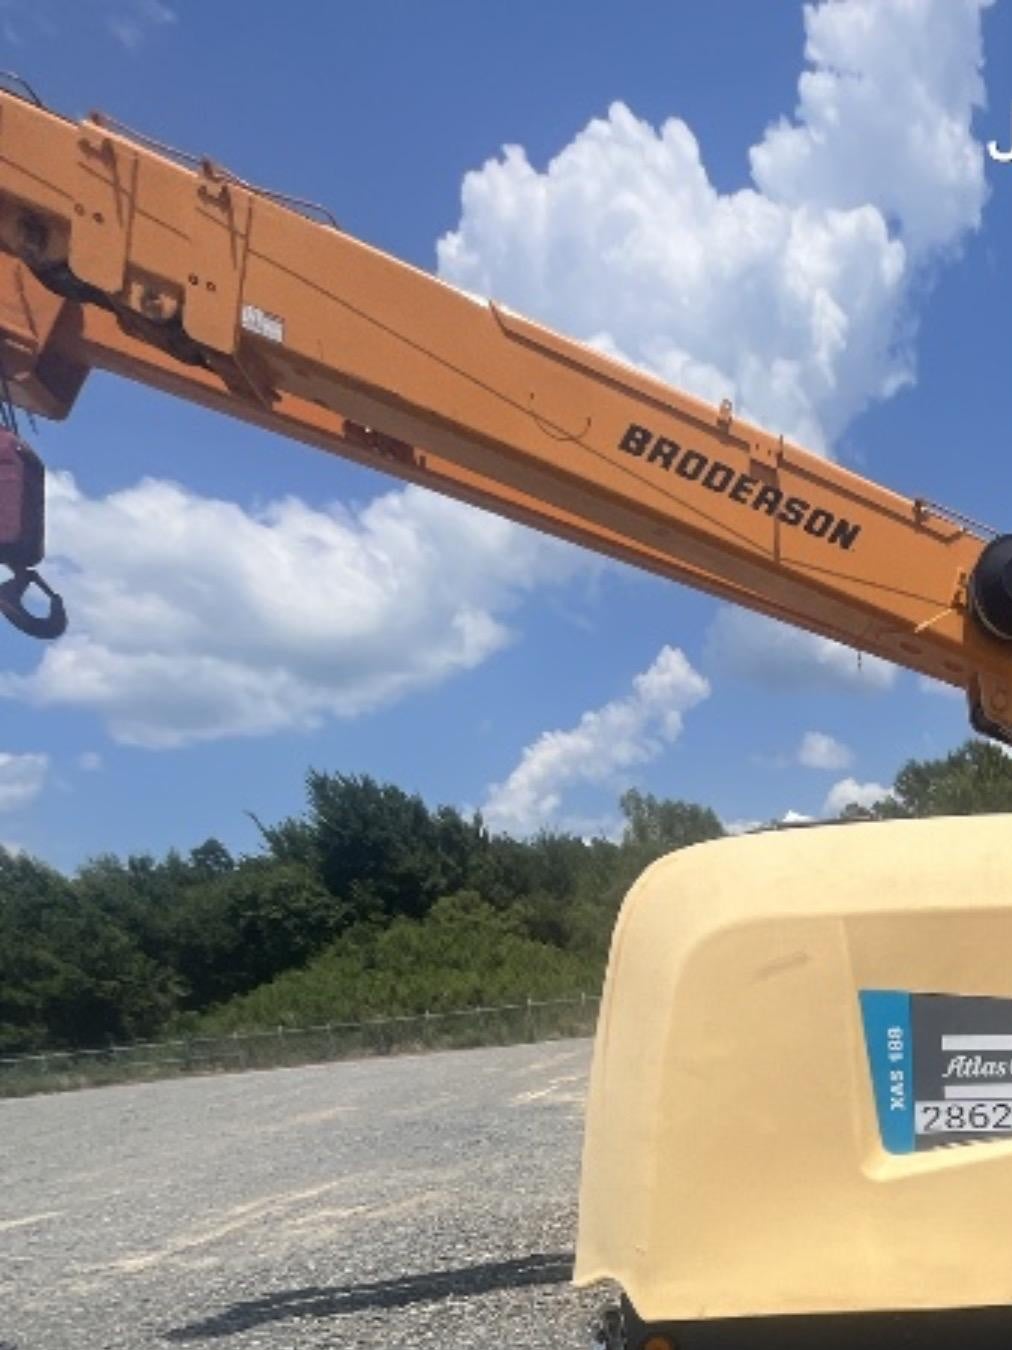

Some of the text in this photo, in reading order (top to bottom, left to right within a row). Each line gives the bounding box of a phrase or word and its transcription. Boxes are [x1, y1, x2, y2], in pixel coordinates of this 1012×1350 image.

[617, 423, 862, 551] BRODERSON
[886, 1026, 906, 1111] XAS 188
[941, 1055, 1007, 1079] Atlas
